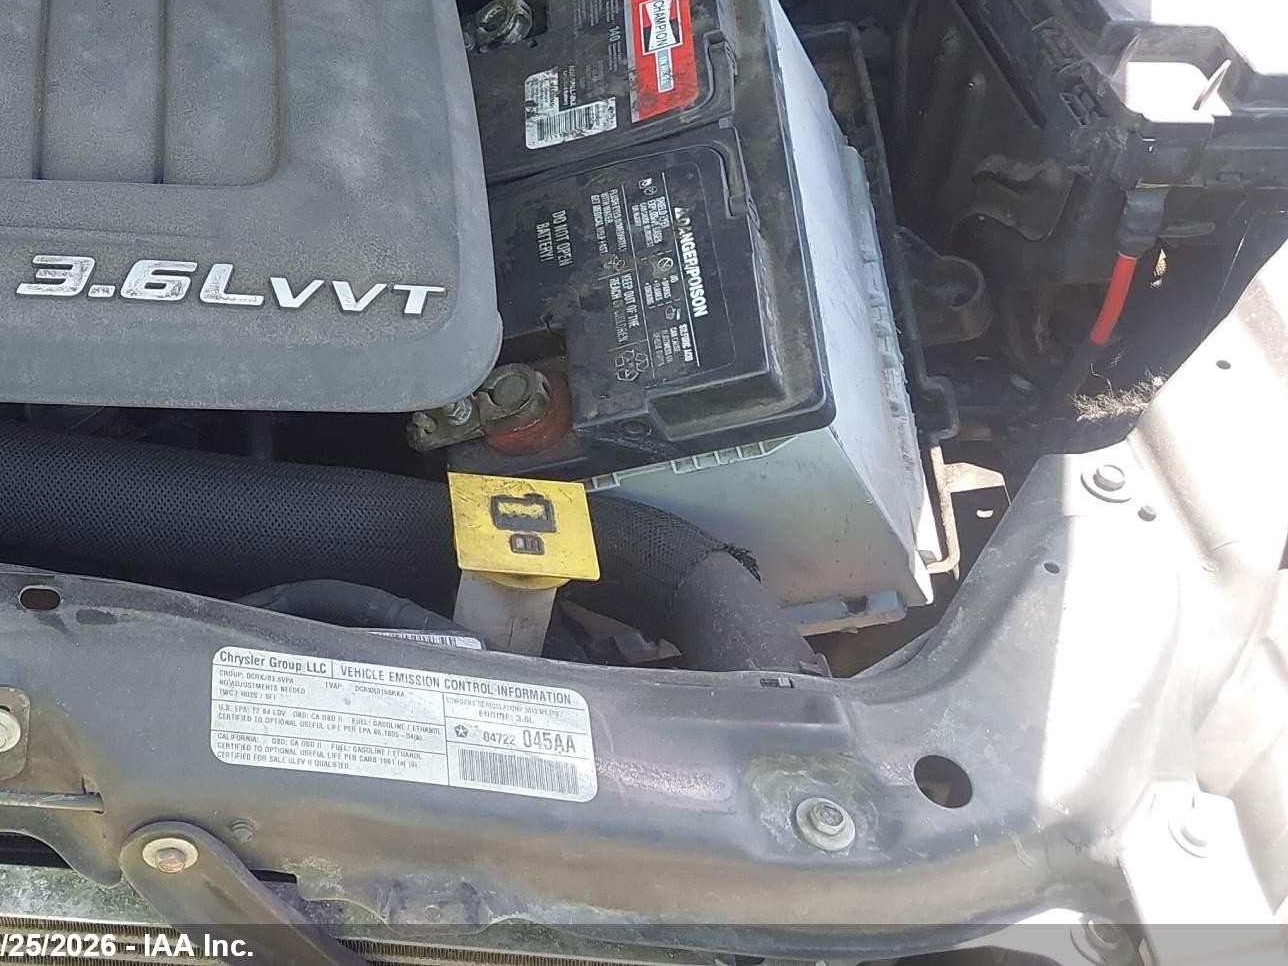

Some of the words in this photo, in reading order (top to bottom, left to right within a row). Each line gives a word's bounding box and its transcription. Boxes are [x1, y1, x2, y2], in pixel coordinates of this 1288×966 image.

[653, 0, 668, 46] CHAMPION
[608, 25, 619, 42] 140
[658, 56, 667, 64] IN
[551, 209, 566, 225] DO
[554, 223, 568, 242] NOT
[536, 221, 553, 263] BATTERY!
[556, 242, 572, 266] OPEN
[676, 217, 707, 317] DANGER/POISON
[608, 276, 621, 300] REACH
[622, 273, 633, 291] KEEP
[624, 290, 635, 304] OUT
[626, 303, 636, 315] OF
[627, 313, 639, 328] THE
[220, 651, 265, 666] Chrysler
[269, 657, 302, 672] Group
[307, 661, 326, 674] LLC
[340, 665, 385, 680] VEHICLE
[389, 671, 440, 687] EMISSION
[444, 678, 493, 695] CONTROL
[497, 685, 571, 704] INFORMATION
[230, 679, 278, 691] ADJUSTMENTS
[280, 685, 305, 694] NEEDED
[218, 712, 252, 722] CERTIFIED
[264, 717, 297, 727] OPTIONAL
[372, 719, 405, 729] GASOLINE
[216, 741, 251, 752] CERTIFIED
[264, 746, 297, 756] OPTIONAL
[217, 732, 259, 743] CALIFORNIA:
[352, 746, 385, 755] GASOLINE
[482, 731, 516, 746] 04722
[523, 729, 577, 754] 045AA
[216, 750, 251, 761] CERTIFIED
[253, 754, 267, 762] FOR
[268, 755, 284, 764] SALE
